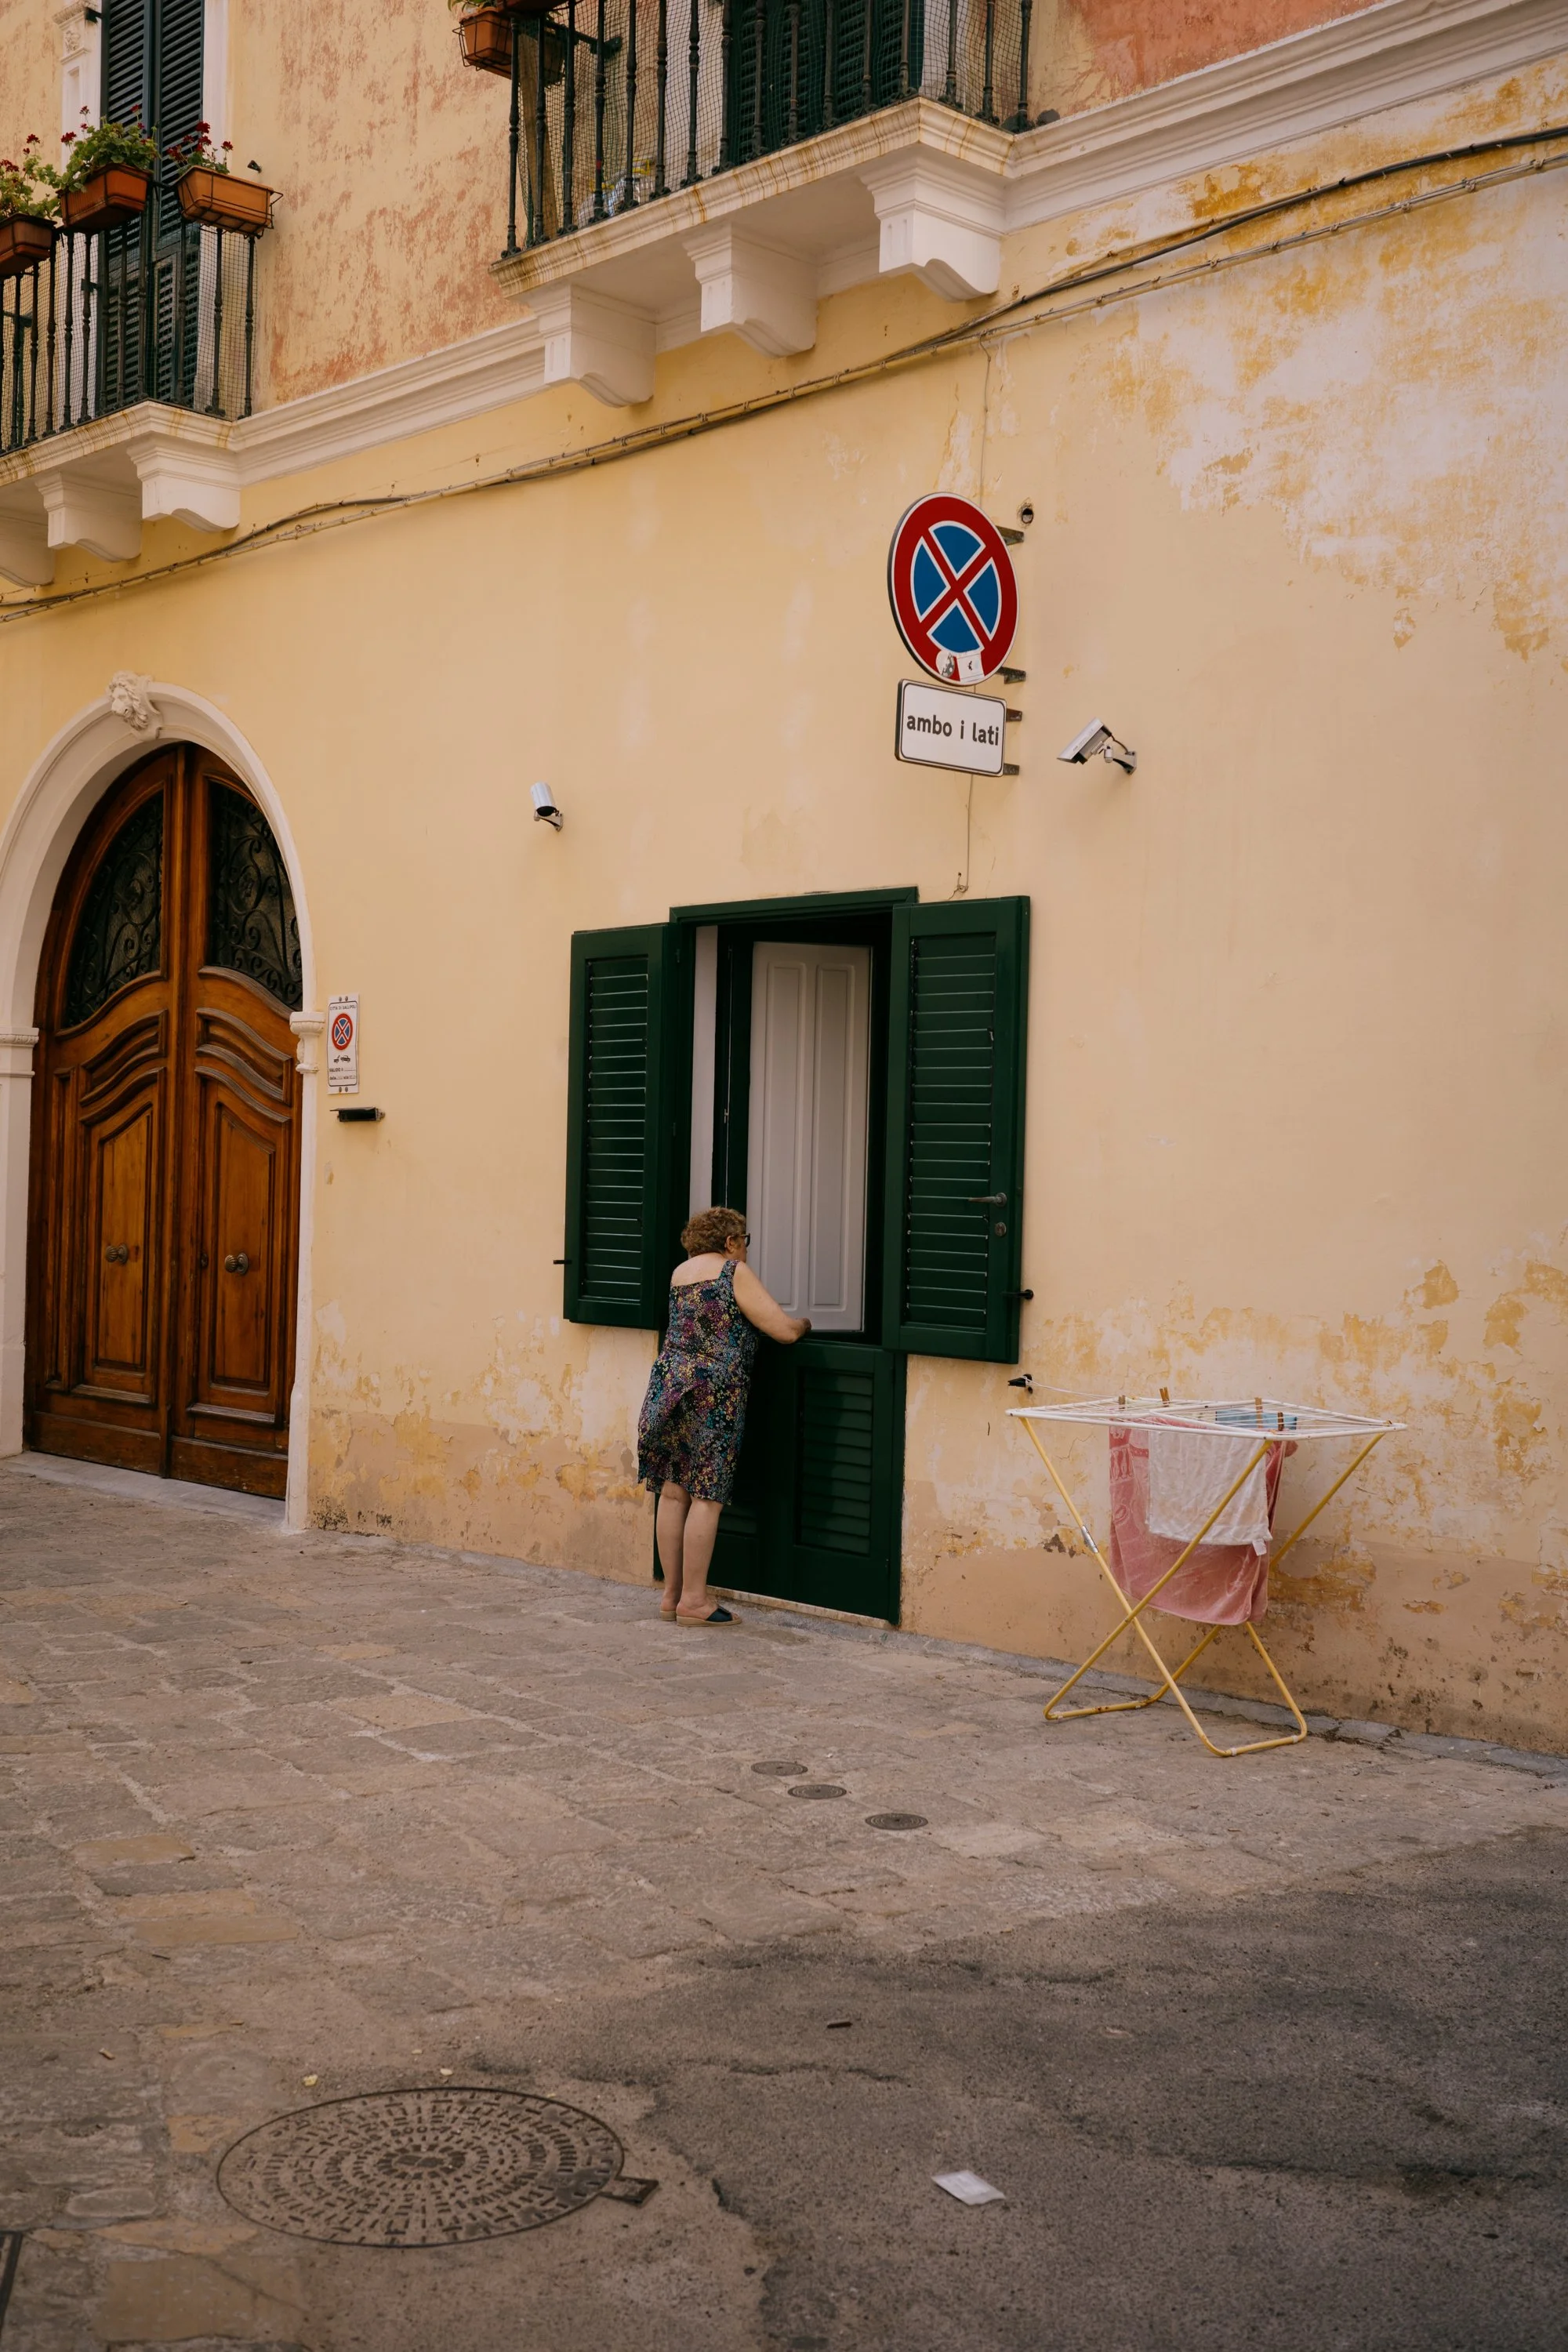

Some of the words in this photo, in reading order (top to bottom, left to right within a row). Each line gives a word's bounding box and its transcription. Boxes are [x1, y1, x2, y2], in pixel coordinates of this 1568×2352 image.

[907, 714, 952, 737] ambo
[960, 720, 965, 739] i
[972, 722, 1000, 746] lati
